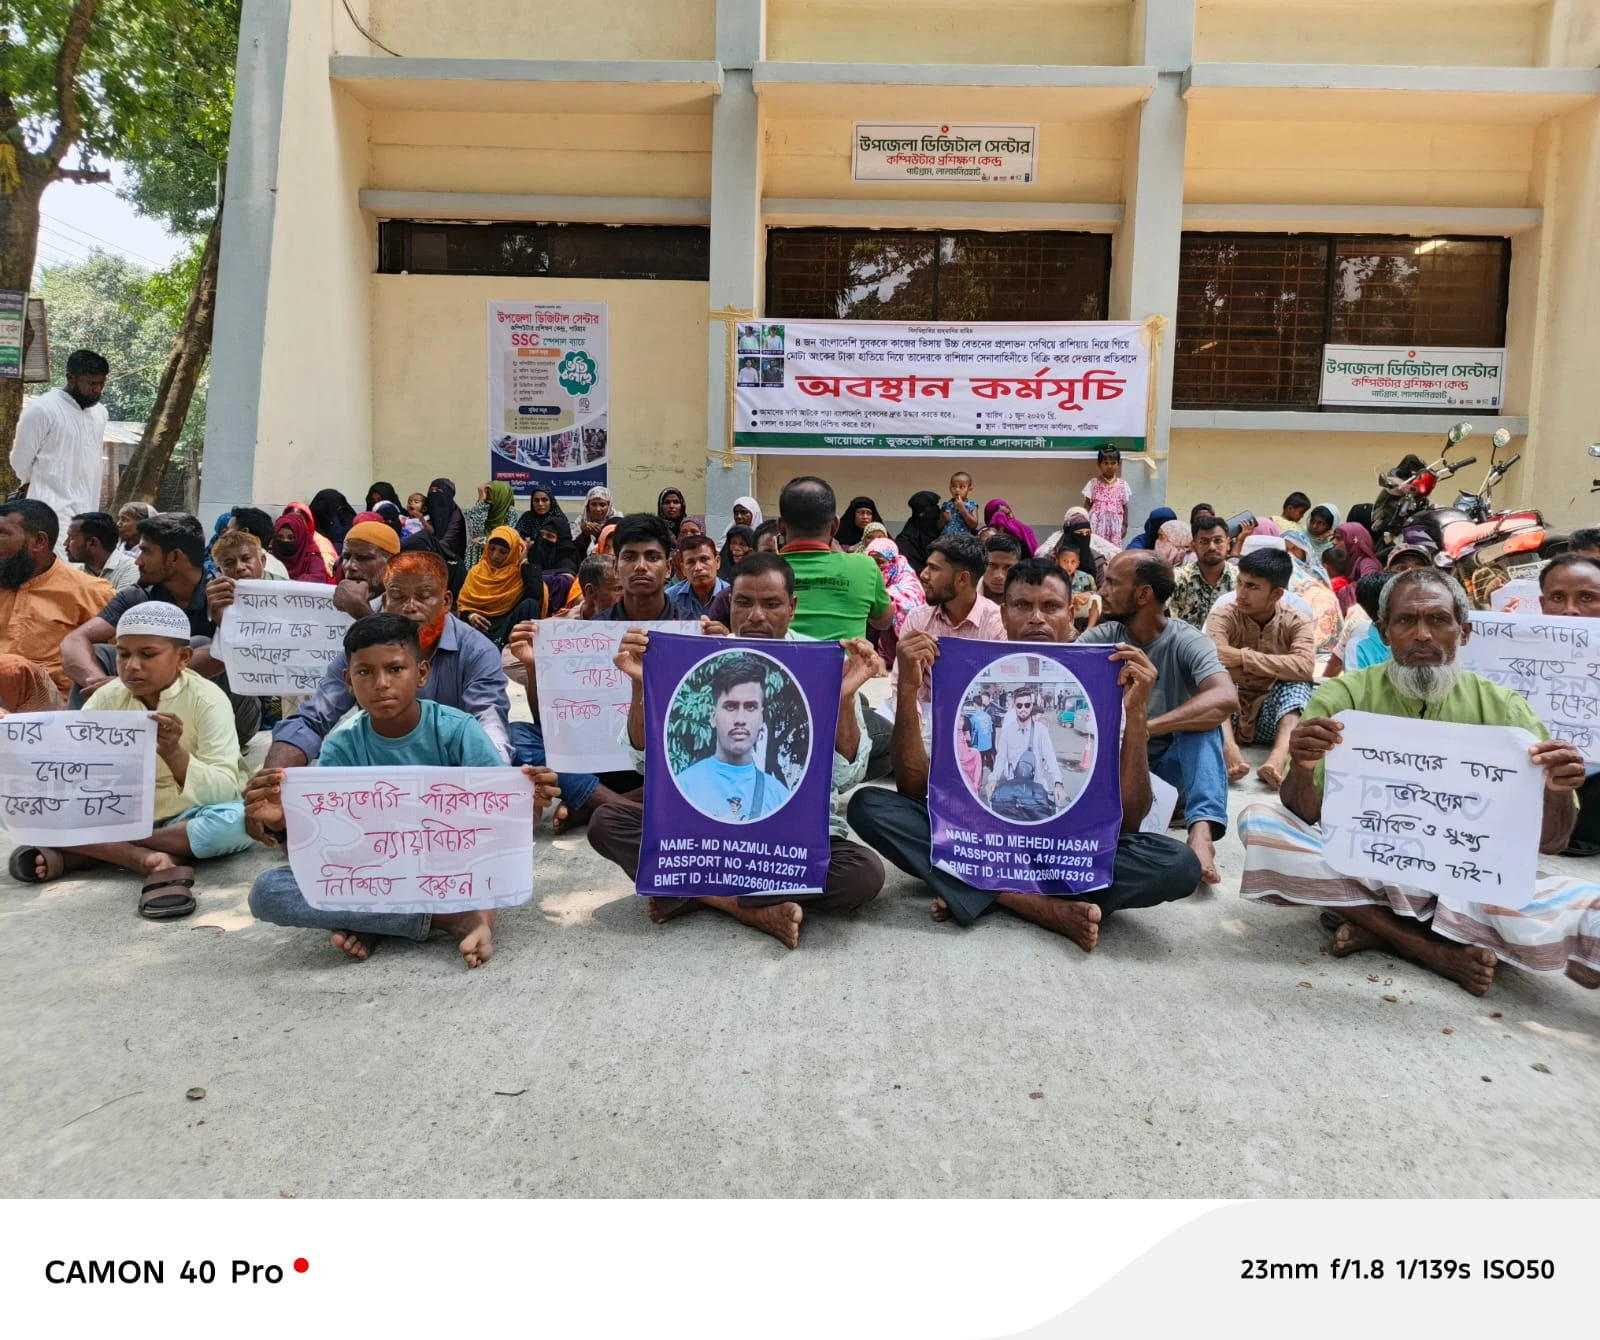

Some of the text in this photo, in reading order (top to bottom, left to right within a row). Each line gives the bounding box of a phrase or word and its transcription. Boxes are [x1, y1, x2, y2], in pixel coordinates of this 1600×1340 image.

[860, 135, 1031, 154] উপজেলা ডিজিটাল সেন্টার
[886, 153, 1002, 167] কম্পিউটার প্রশিক্ষণ কেন্দ্র
[935, 167, 981, 176] লালমনিরহাট
[497, 311, 599, 325] উপজেলা ডিজিটাল সেন্টার
[511, 333, 539, 346] SSC
[795, 336, 1129, 349] ৪ জন বাংলাদেশি যুবককে কাজের ভিসায় উচ্চ বেতনের প্রলোভন দেখিয়ে রাশিয়ায় নিয়ে গিয়ে
[787, 350, 806, 361] মোটা
[808, 352, 835, 361] অংকের
[838, 350, 855, 361] টাকা
[858, 350, 885, 361] হাতিয়ে
[886, 351, 905, 361] নিয়ে
[906, 353, 941, 362] তাদেরকে
[944, 351, 973, 362] রাশিয়ান
[976, 352, 1028, 363] সেনাবাহিনীতে
[1031, 352, 1050, 363] বিক্রি
[1053, 355, 1070, 363] করে
[1072, 355, 1101, 363] দেওয়ার
[1103, 352, 1138, 363] প্রতিবাদে
[1326, 358, 1499, 379] উপজেলা ডিজিটাল সেন্টার
[795, 367, 1127, 411] অবস্থান কর্মসূচি
[1351, 375, 1469, 391] কম্পিউটার প্রশিক্ষণ কেন্দ্র
[824, 435, 1047, 448] আয়োজনে ভুক্তভোগী পরিবার ও এলাকাবাসী
[238, 593, 279, 609] মানব
[236, 621, 283, 637] দালাল
[288, 623, 319, 638] দের
[1529, 625, 1589, 648] পাচার
[233, 644, 300, 665] আইনের
[237, 672, 284, 685] আনা
[1498, 657, 1577, 681] করতে
[0, 722, 44, 745] চার
[31, 761, 114, 782] দেশে
[1352, 747, 1518, 782] আমাদের চার
[0, 786, 133, 816] ফেরত চাই
[418, 783, 521, 815] পরিবারের
[1385, 783, 1478, 812] ভাইদের
[1352, 810, 1423, 834] জীবিত
[1422, 824, 1436, 836] ও
[365, 818, 492, 859] ন্যায়বিচার
[945, 829, 1099, 852] NAME- MD MEHEDI HASAN
[660, 839, 808, 860] NAME- MD NAZMUL ALOM
[953, 845, 1012, 864] PASSPORT
[1014, 853, 1032, 865] NO
[658, 855, 807, 878] PASSPORT NO -A18122677
[949, 861, 979, 875] BMET
[982, 866, 994, 878] ID
[416, 872, 473, 900] করুন
[654, 873, 687, 887] BMET
[689, 872, 701, 884] ID
